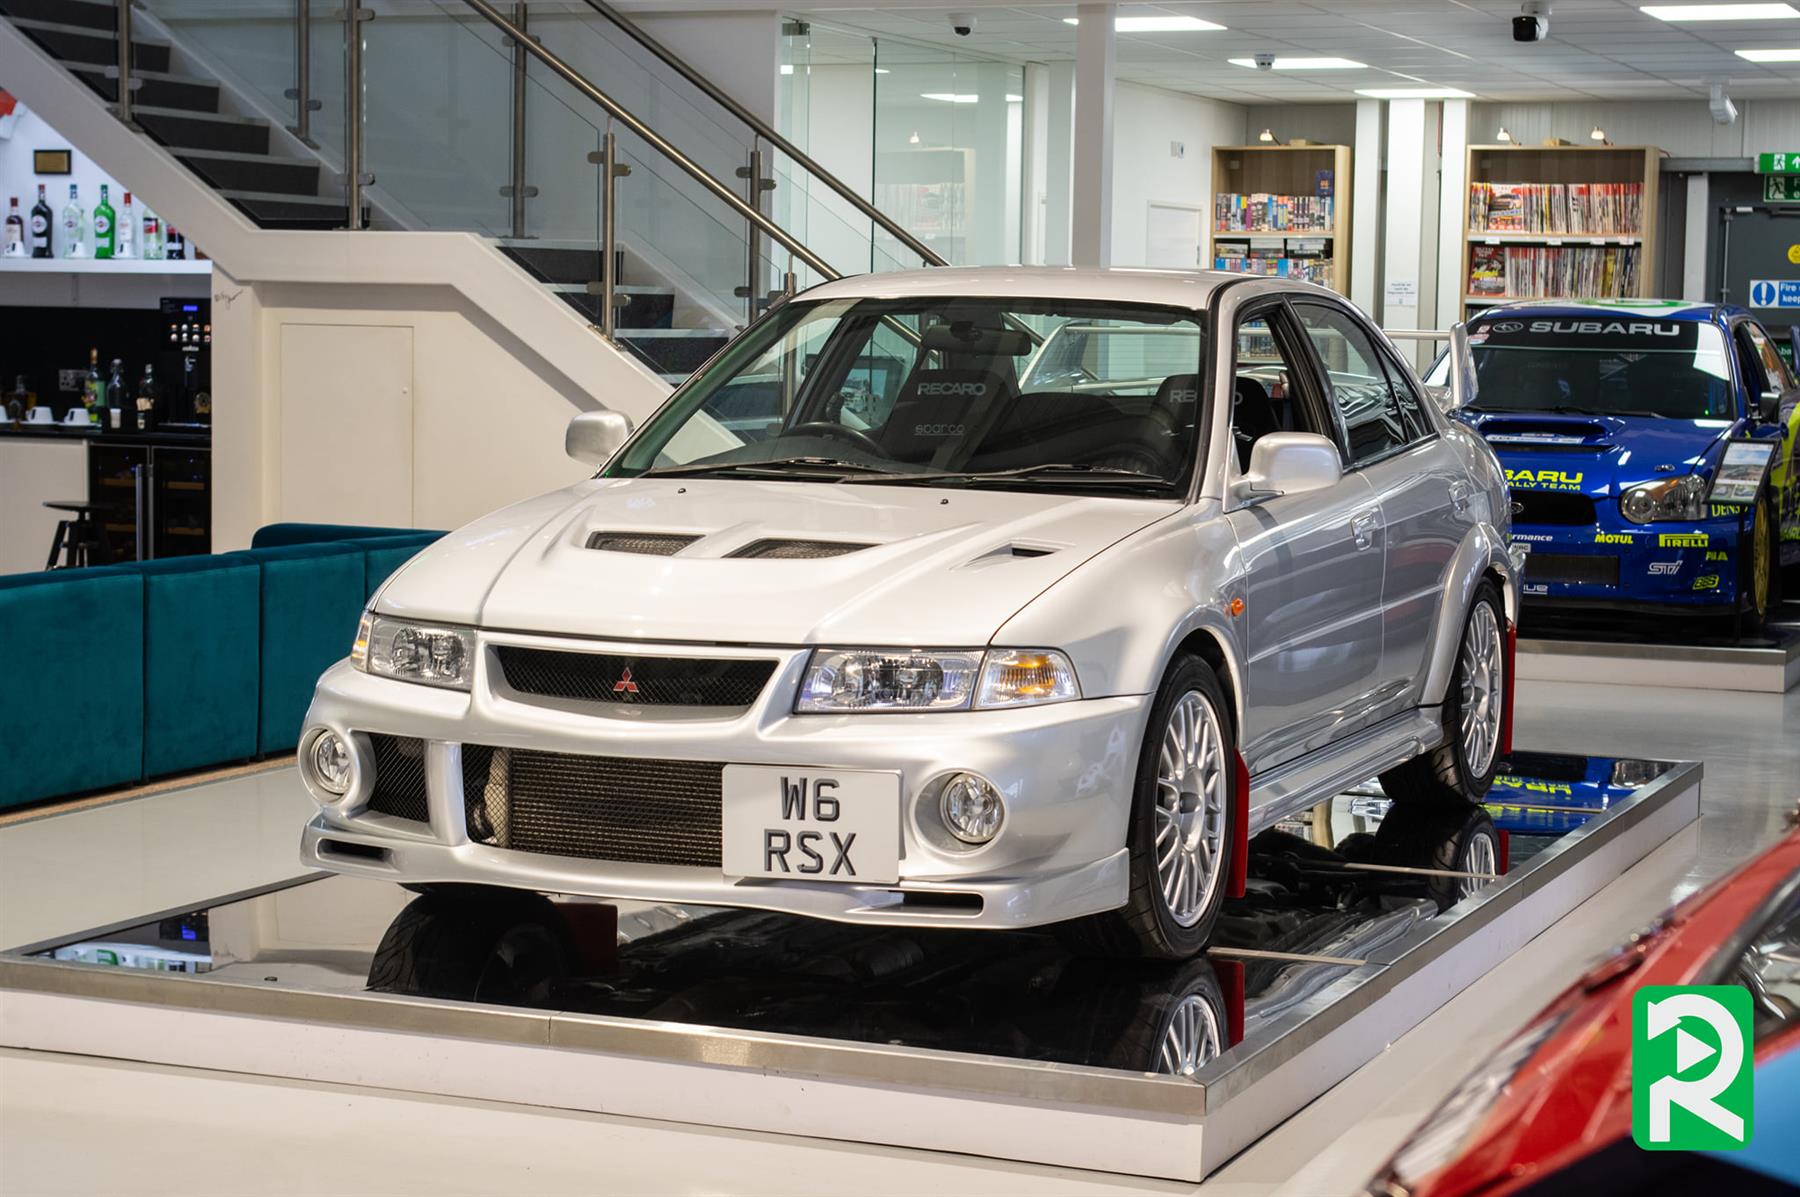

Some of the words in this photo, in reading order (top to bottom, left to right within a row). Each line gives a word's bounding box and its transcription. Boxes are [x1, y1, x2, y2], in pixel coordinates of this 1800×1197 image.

[1529, 321, 1680, 336] SUBARU
[917, 383, 986, 396] RECARO
[1504, 469, 1583, 484] BARU
[1541, 482, 1581, 490] TEAM
[1511, 533, 1553, 542] rmance
[1595, 533, 1633, 544] MOTUL
[1659, 533, 1709, 547] PIRELLI
[780, 776, 841, 822] W6
[764, 828, 857, 876] RSX
